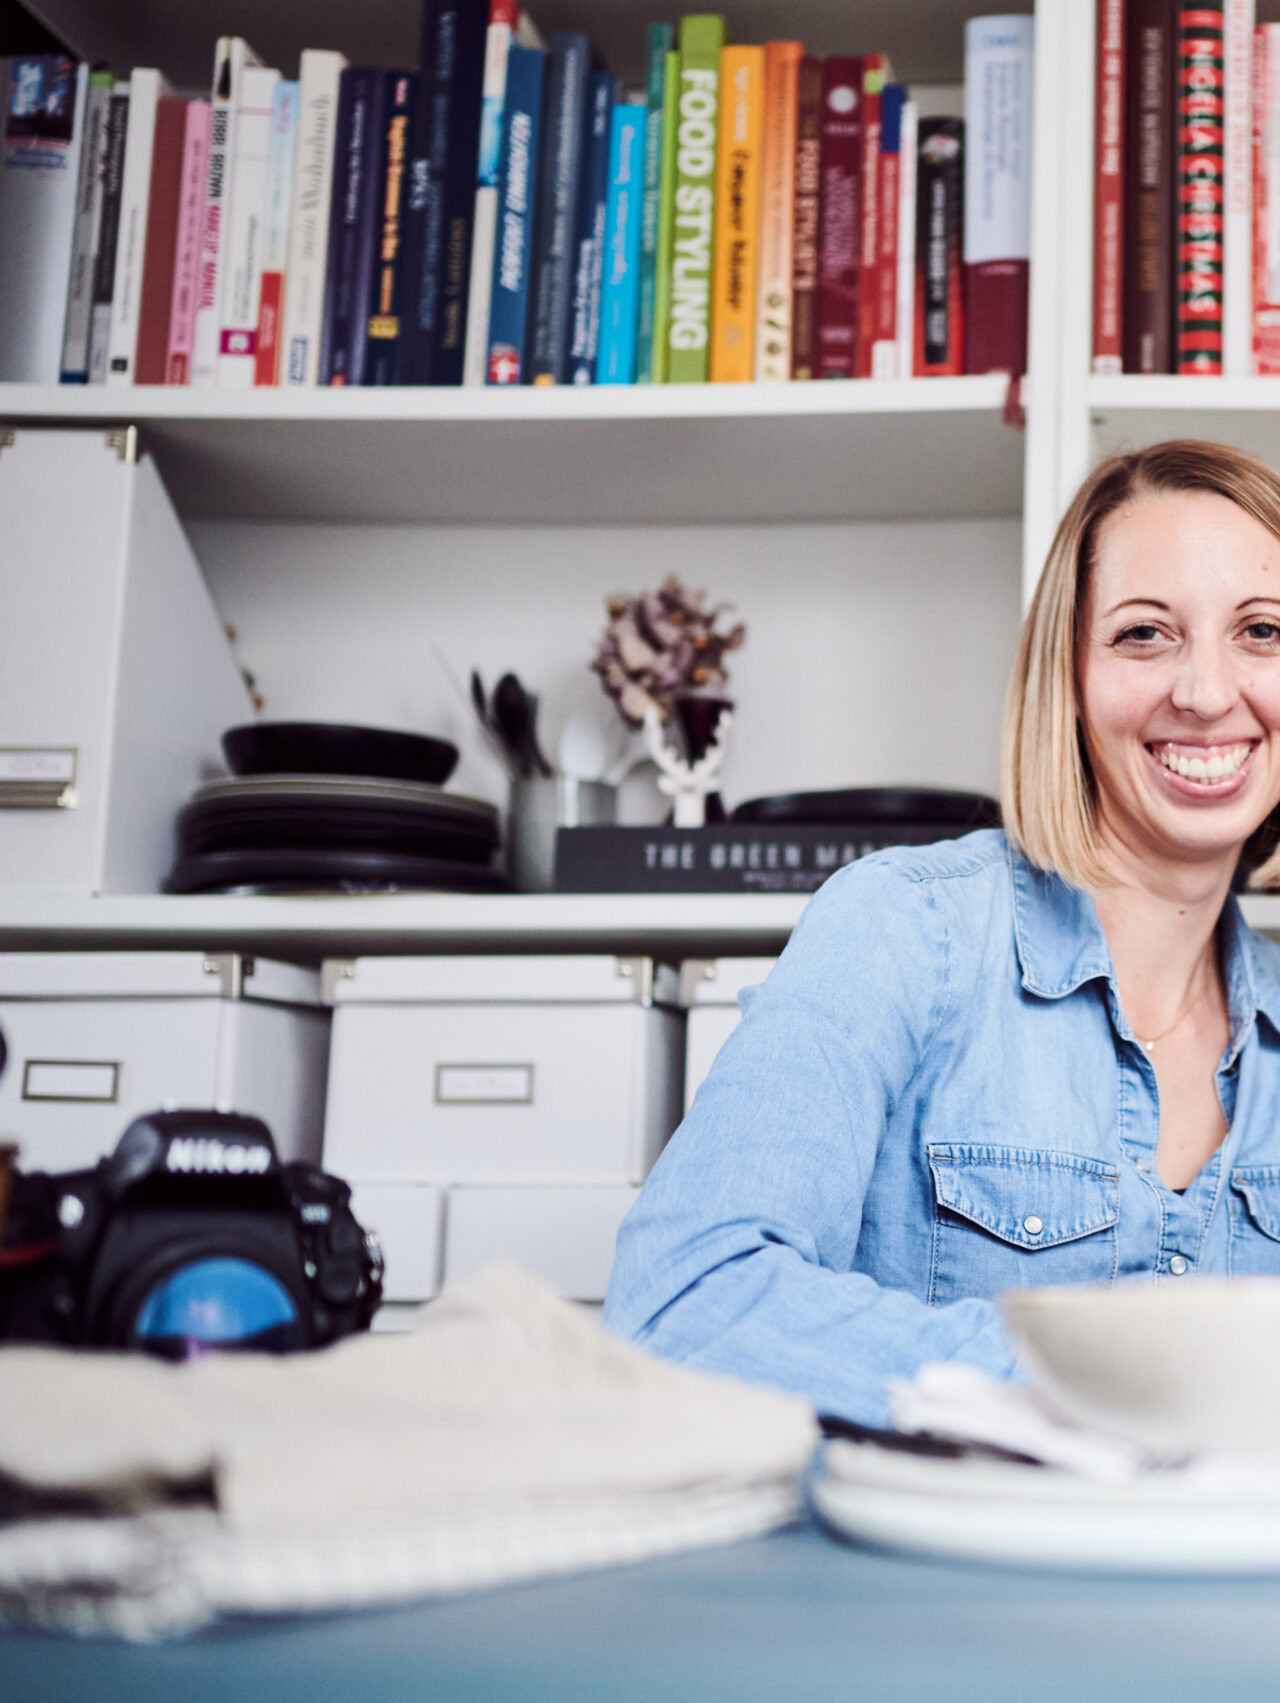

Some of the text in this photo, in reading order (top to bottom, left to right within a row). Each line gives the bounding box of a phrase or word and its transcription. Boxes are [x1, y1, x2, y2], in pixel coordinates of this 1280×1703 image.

[670, 68, 717, 351] FOOD STYLING
[1188, 39, 1217, 313] NIGELLA CHRISTMAS
[643, 842, 697, 870] THE
[708, 842, 803, 870] GREEN
[166, 1136, 273, 1176] Nikon
